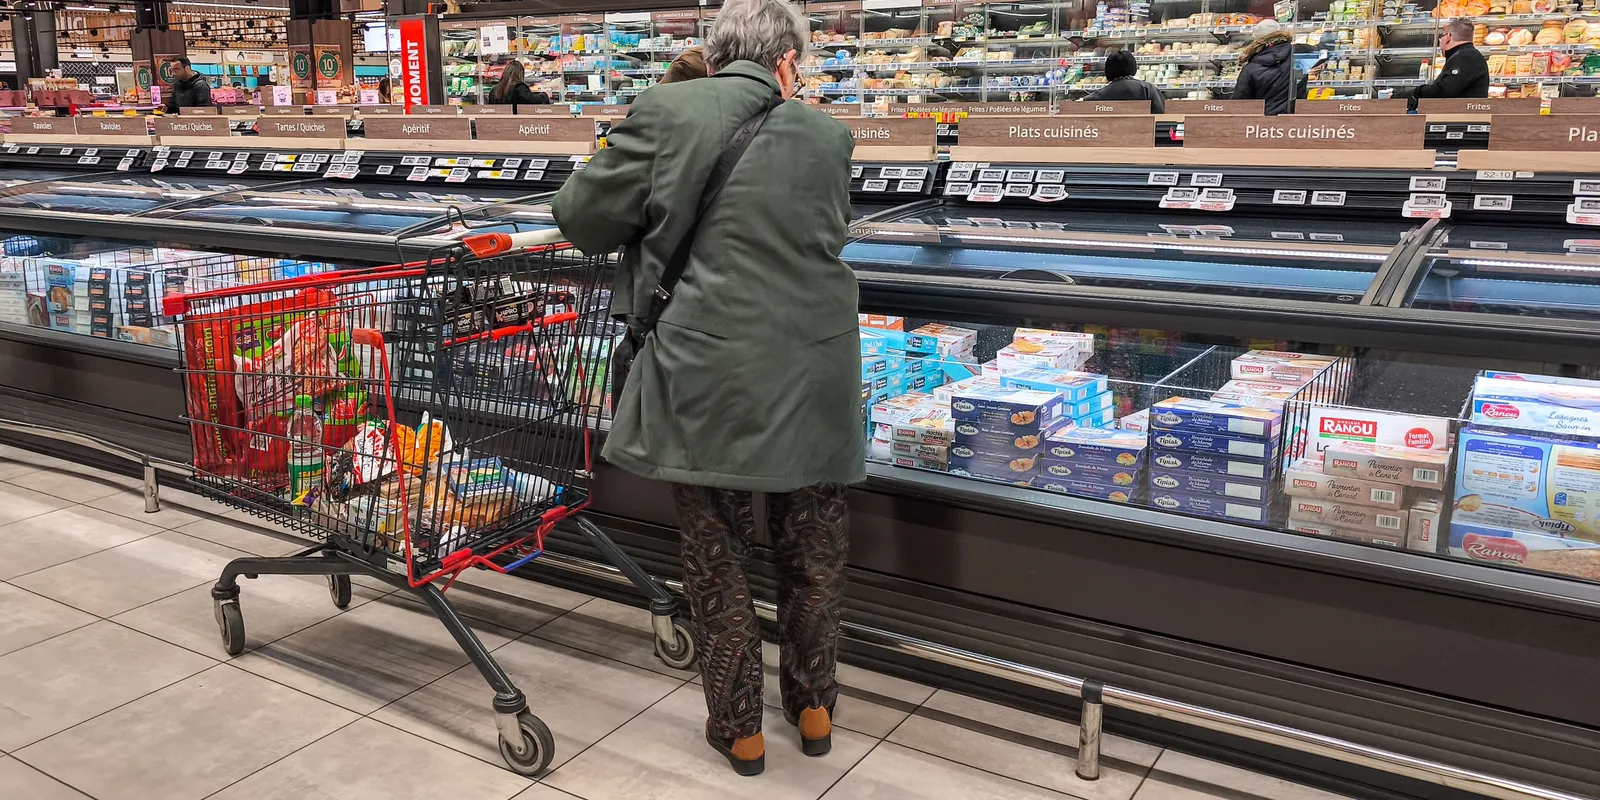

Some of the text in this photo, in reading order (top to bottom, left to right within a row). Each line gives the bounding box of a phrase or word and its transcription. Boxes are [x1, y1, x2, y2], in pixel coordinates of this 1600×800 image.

[406, 40, 423, 106] MOMENT
[827, 106, 849, 114] légumes
[939, 106, 963, 114] légumes
[1021, 105, 1047, 114] légumes
[1339, 103, 1361, 111] Frites
[1467, 103, 1491, 111] Frites
[32, 122, 52, 130] Ravioles
[100, 122, 121, 131] Ravioles
[170, 122, 186, 131] Tartes
[191, 122, 213, 132] Quiches
[276, 122, 296, 131] Tartes
[301, 122, 326, 132] Quiches
[402, 123, 430, 135] Apéritif
[518, 123, 551, 136] Apéritif
[850, 127, 890, 139] uisinés
[1009, 125, 1099, 138] Plats cuisinés
[1246, 124, 1355, 139] Plats cuisinés
[1483, 171, 1511, 179] 52-10
[1241, 365, 1263, 373] RANOU
[1484, 407, 1518, 419] Ranou
[1547, 411, 1589, 423] Lasagnes
[1159, 415, 1180, 424] Tipiak
[958, 426, 976, 434] Tipiak
[1323, 418, 1374, 435] RANOU
[1555, 420, 1591, 431] Saumon
[925, 429, 943, 437] Hachis
[1159, 437, 1180, 446] Tipiak
[1053, 448, 1072, 457] Tipiak
[1159, 458, 1180, 467] Tipiak
[1333, 459, 1356, 468] RANOU
[1368, 460, 1403, 472] Parmentier
[1050, 466, 1069, 475] Tipiak
[1375, 469, 1400, 480] Canard
[1156, 478, 1176, 487] Tipiak
[1293, 479, 1317, 488] RANOU
[1326, 479, 1361, 492] Parmentier
[1333, 490, 1358, 500] Canard
[1157, 499, 1177, 508] Tipiak
[1300, 504, 1322, 513] RANOU
[1332, 505, 1367, 518] Parmentier
[1339, 515, 1364, 525] Canard
[1422, 519, 1430, 541] RANOU
[1538, 520, 1571, 532] Tipiak
[1467, 542, 1524, 565] Ranou
